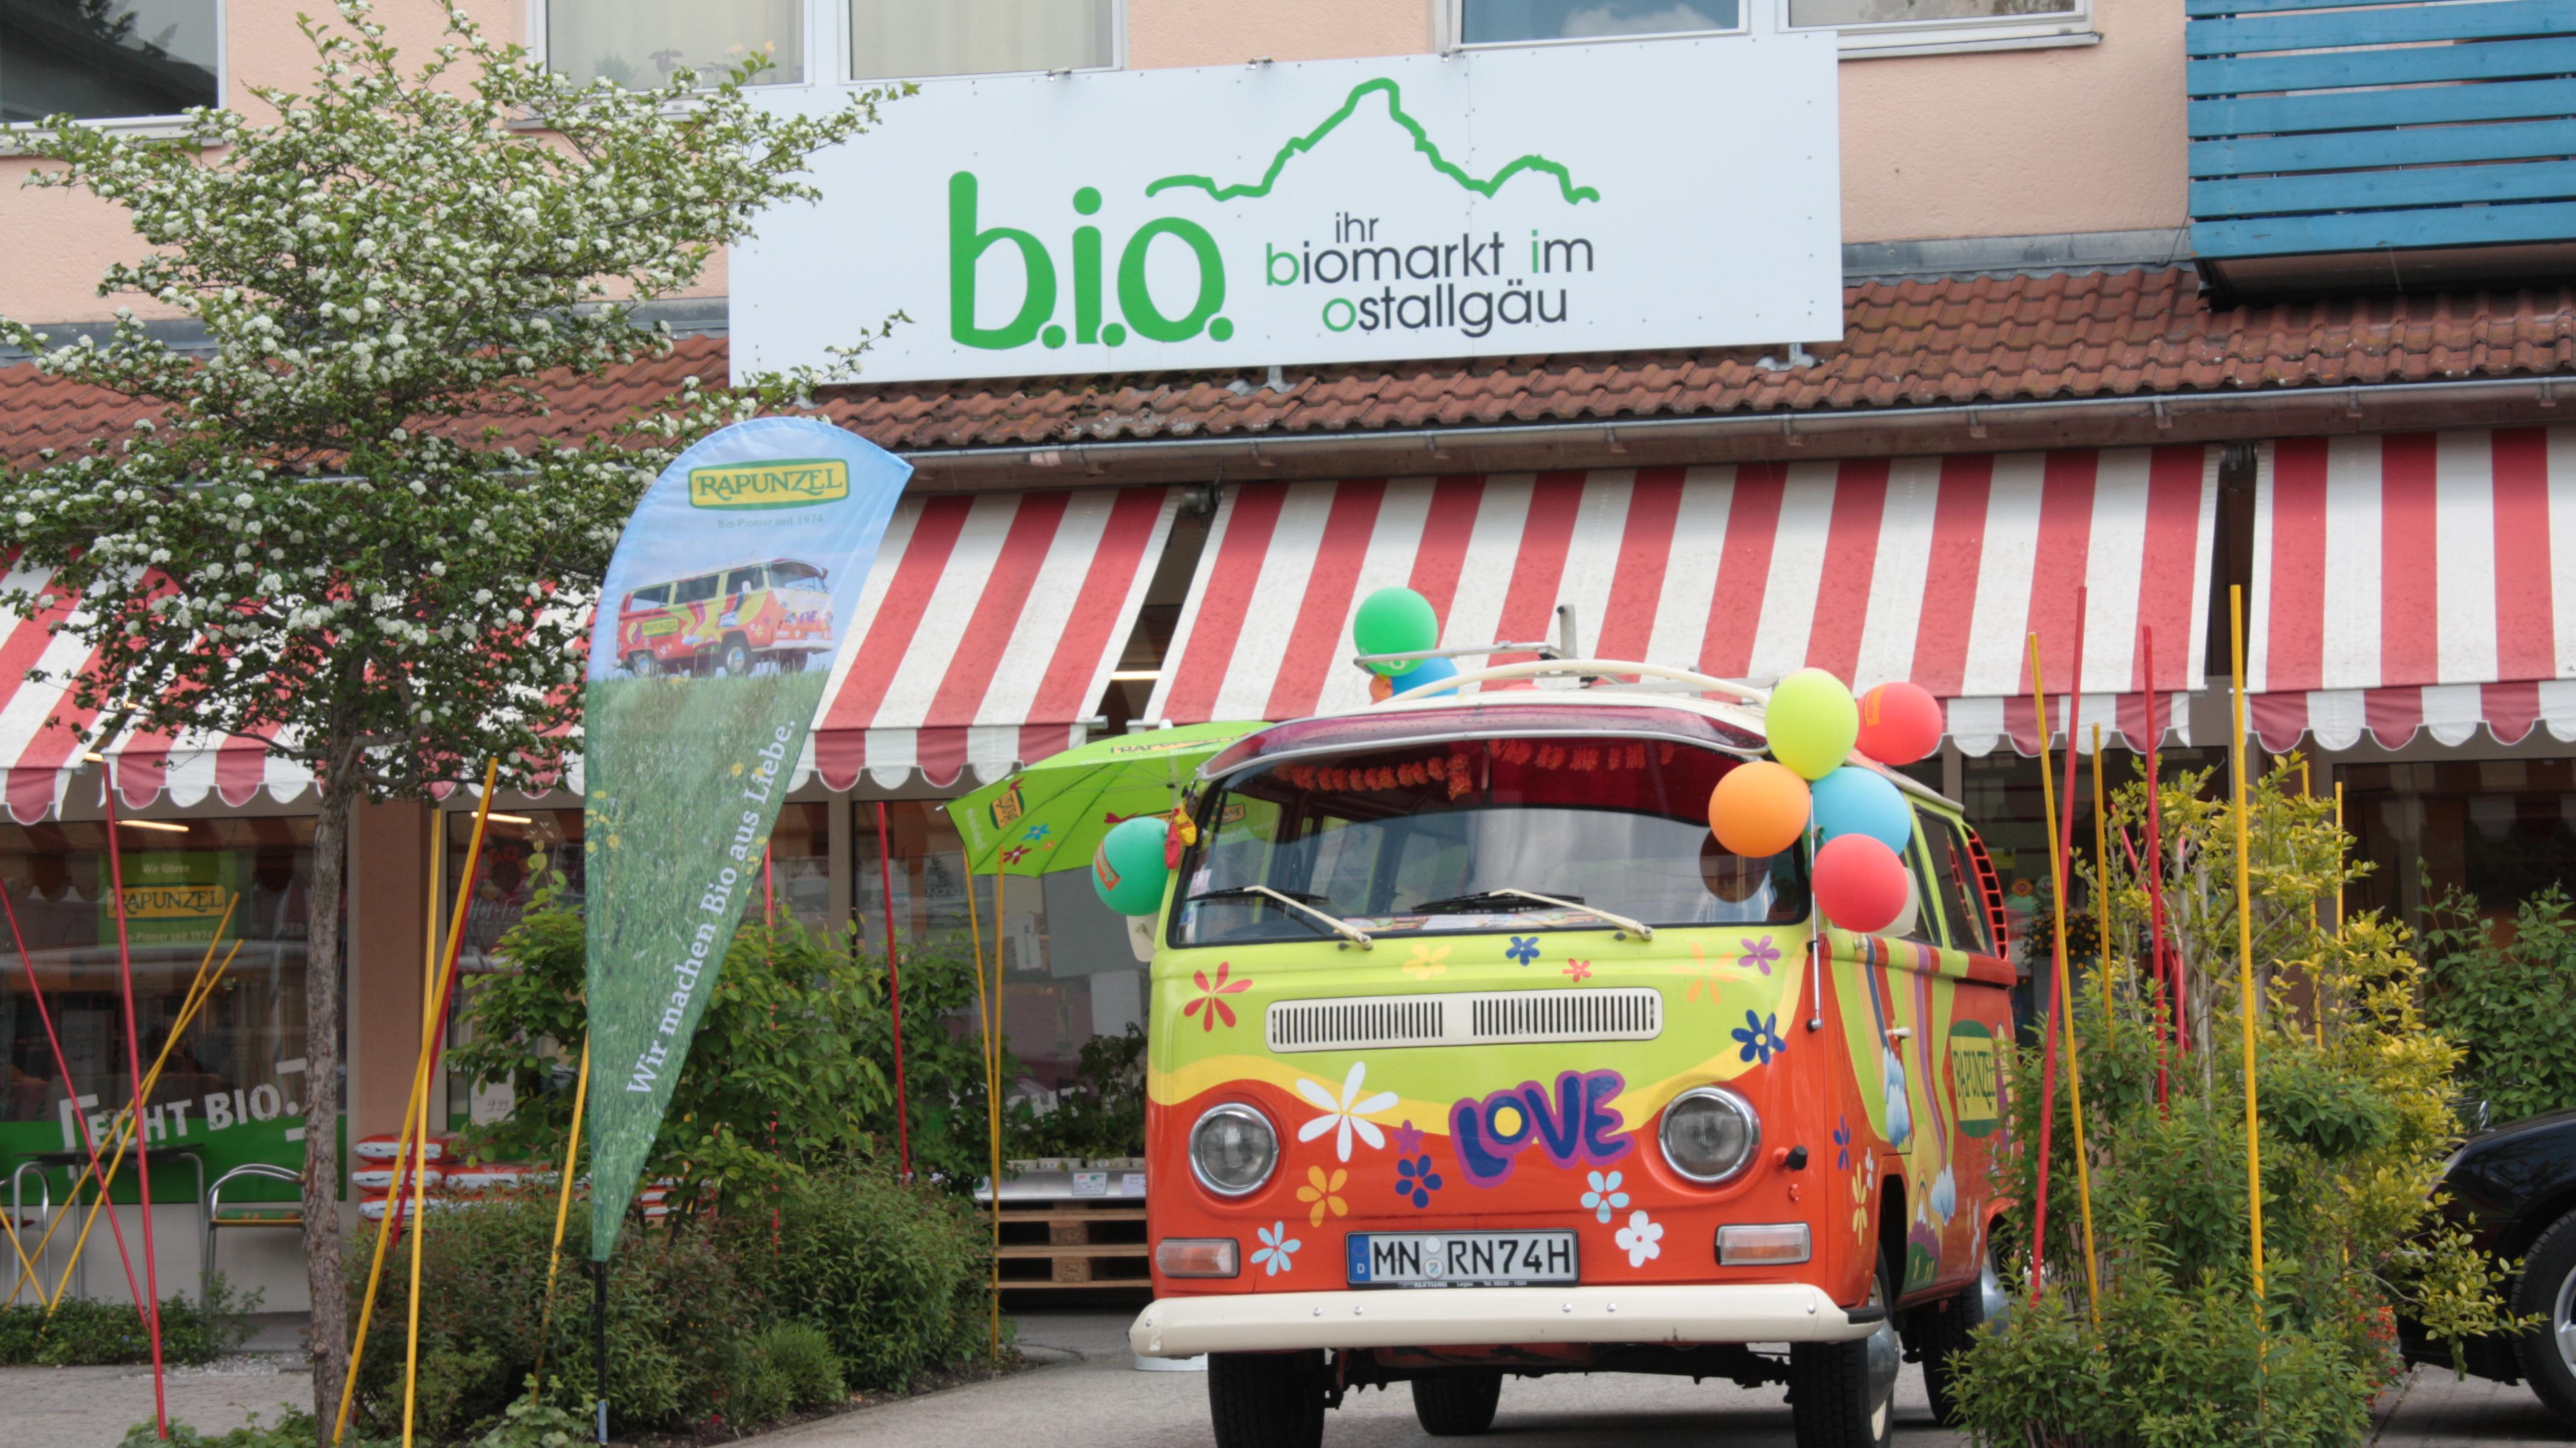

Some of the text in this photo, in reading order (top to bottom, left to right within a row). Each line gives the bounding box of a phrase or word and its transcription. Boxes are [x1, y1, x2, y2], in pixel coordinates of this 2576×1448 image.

[1336, 212, 1379, 243] ihr
[1266, 229, 1594, 286] biomarkt im
[1322, 279, 1567, 338] ostallgäu
[695, 468, 843, 502] RAPUNZEL
[718, 514, 824, 529] Bio-Pionier seit 1974
[142, 863, 191, 874] Wir führen
[626, 720, 796, 1094] Wir machen Bio aus Liebe.
[128, 931, 168, 942] o-Pionier
[1953, 1050, 1997, 1113] RAPUNZEL
[204, 1083, 300, 1132] BIO.
[1448, 1069, 1634, 1189] LOVE
[1356, 1263, 1365, 1274] D
[1373, 1239, 1571, 1276] MN RN74H
